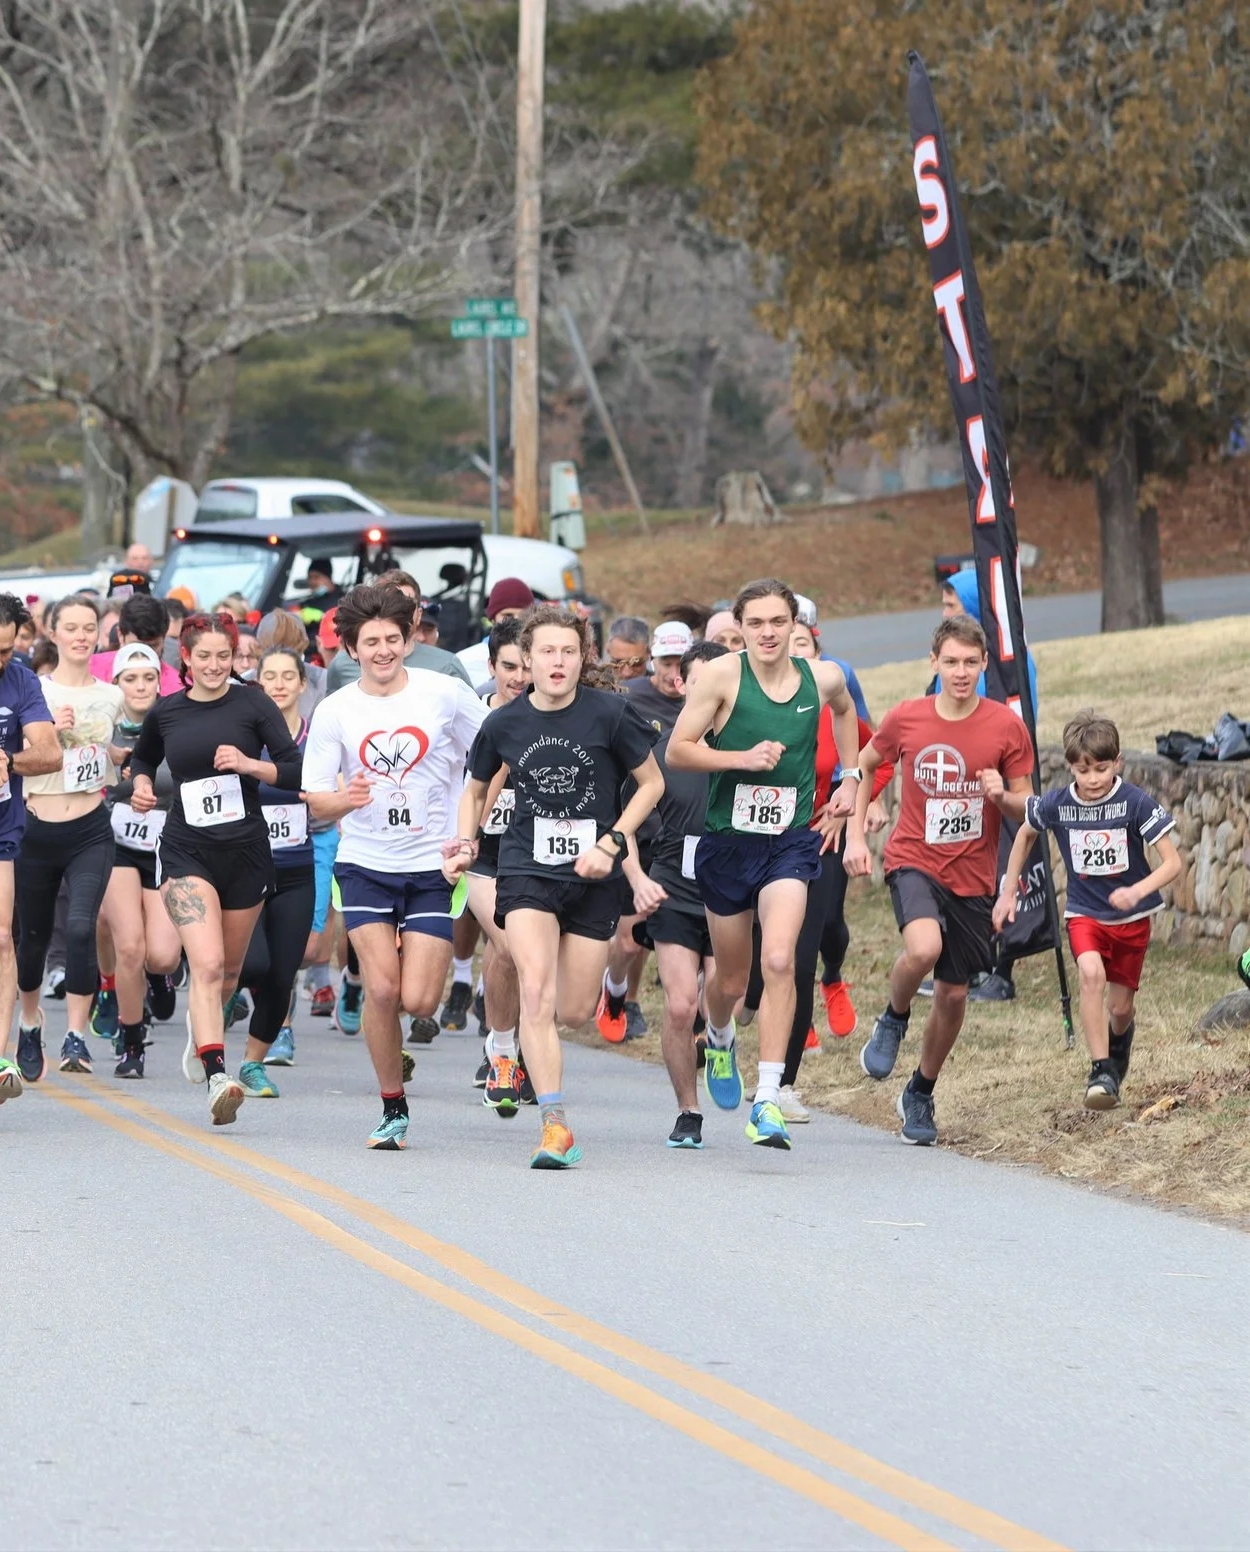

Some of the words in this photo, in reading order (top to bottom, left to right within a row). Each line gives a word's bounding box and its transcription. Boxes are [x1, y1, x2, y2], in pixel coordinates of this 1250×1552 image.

[518, 734, 570, 768] moondance
[572, 744, 595, 767] 2017
[76, 760, 100, 782] 224
[202, 794, 222, 815] 87
[559, 806, 571, 818] of
[575, 780, 596, 812] magic
[388, 808, 412, 826] 84
[748, 804, 782, 825] 185
[1058, 805, 1077, 822] WALT
[1078, 805, 1102, 821] DISNEY
[1104, 800, 1128, 820] WORLD
[124, 822, 148, 840] 174
[939, 815, 971, 835] 235
[547, 836, 580, 856] 135
[1082, 849, 1117, 866] 236
